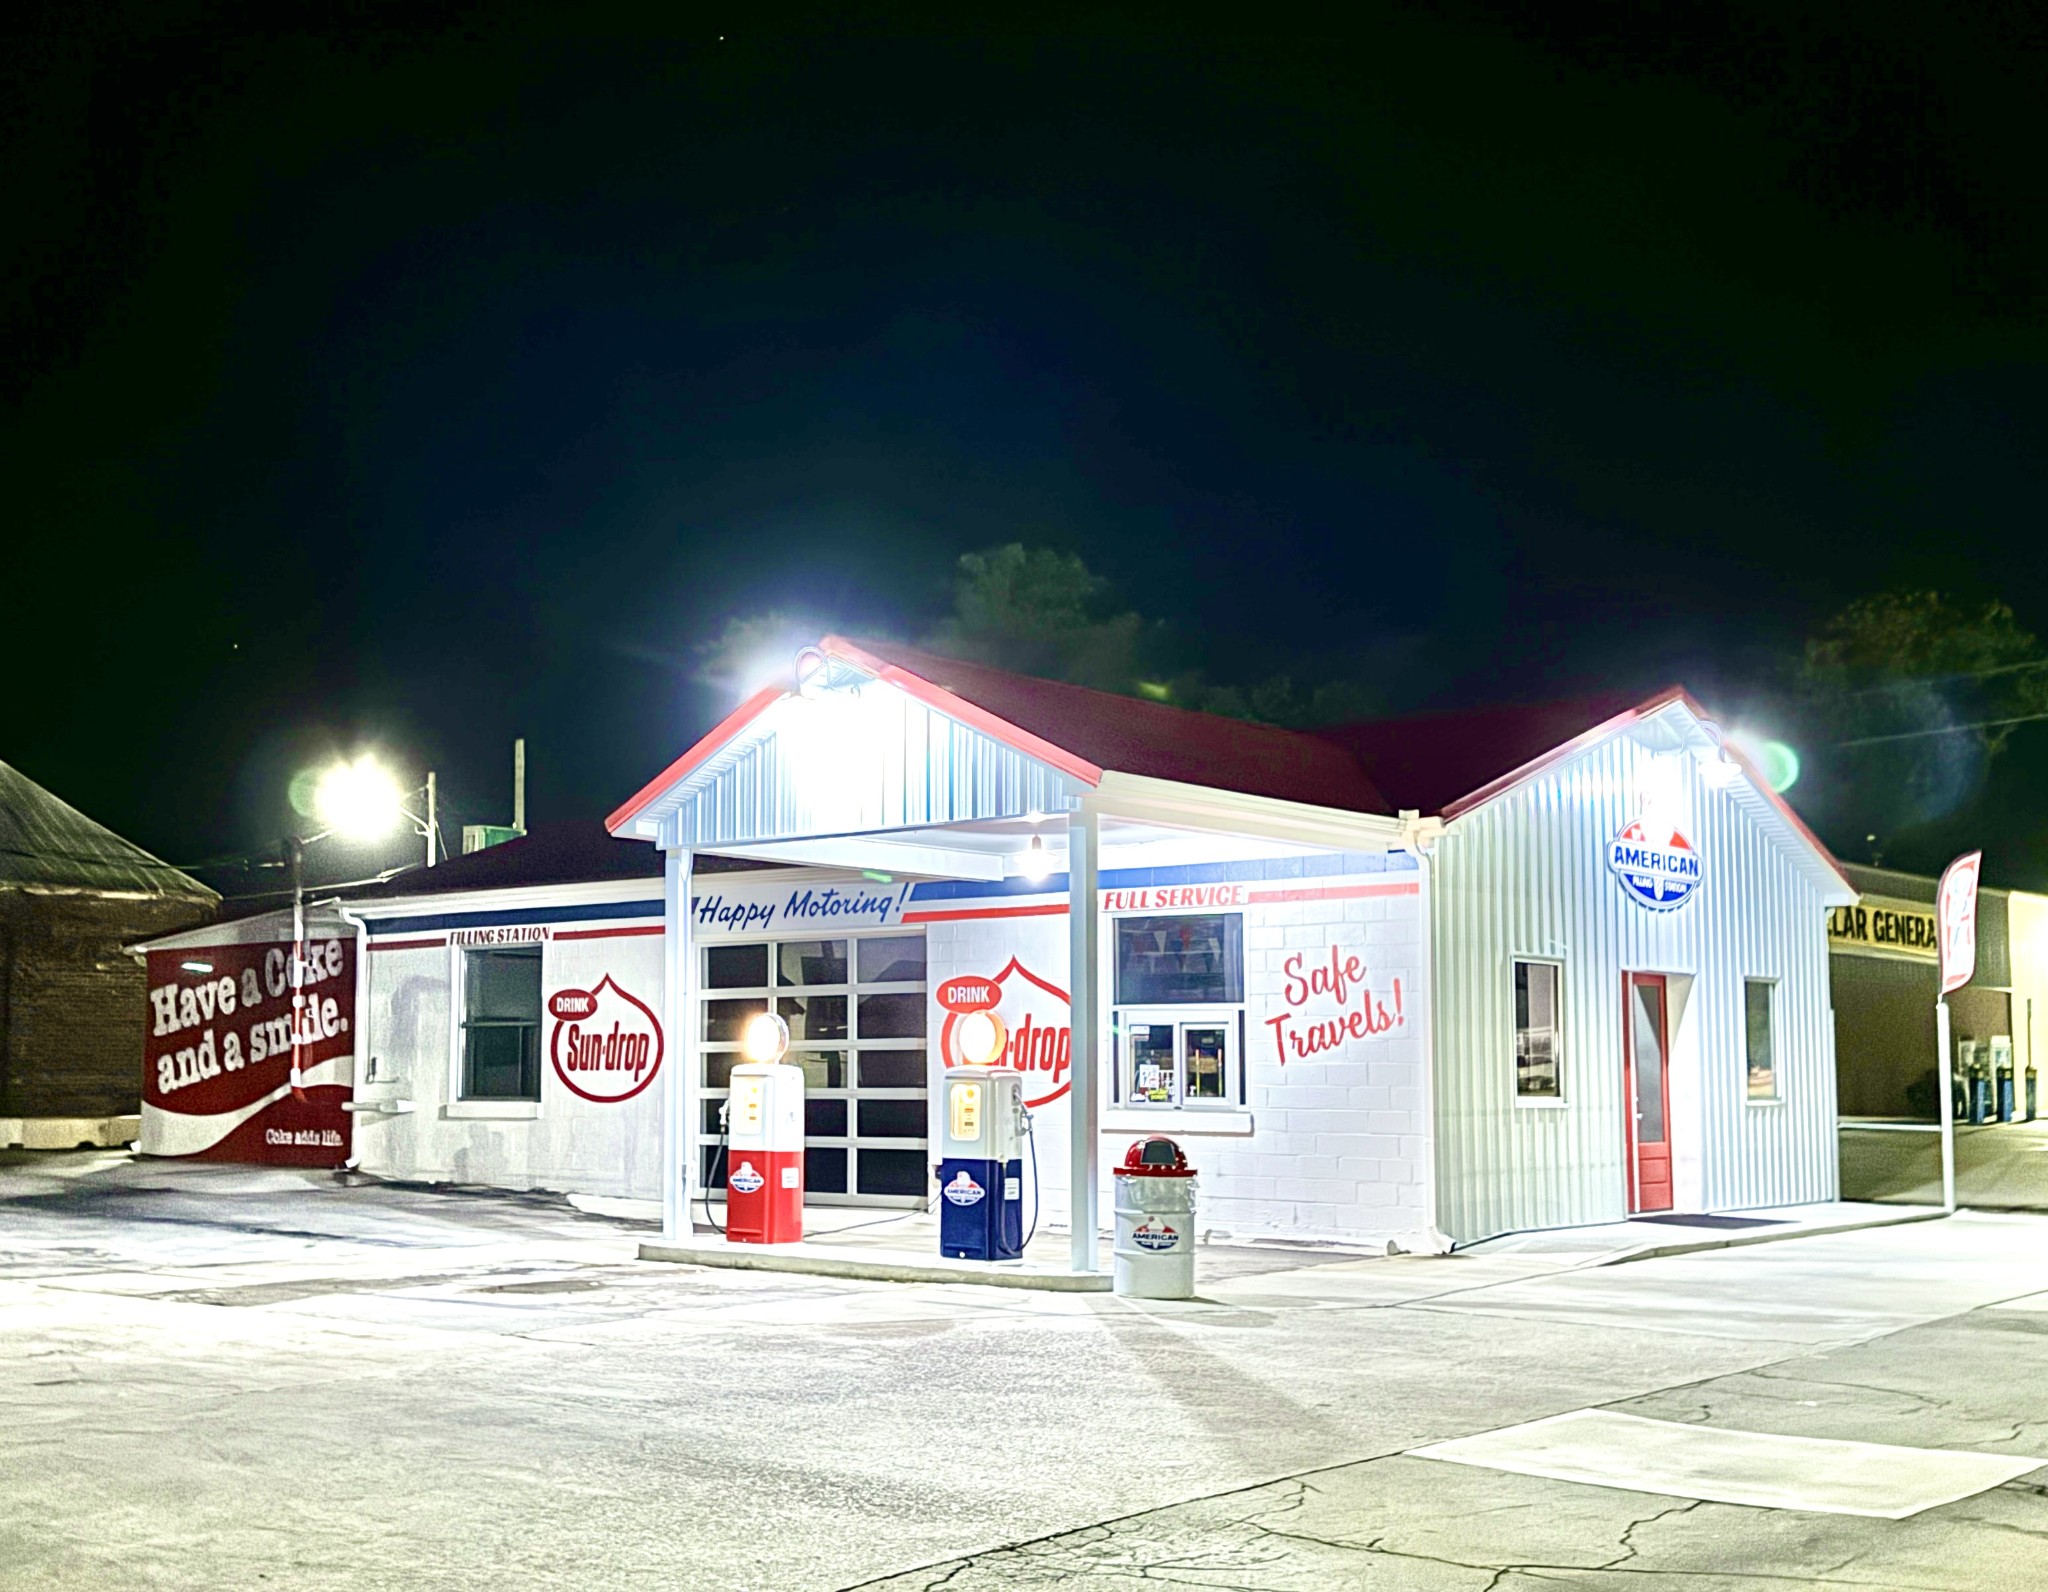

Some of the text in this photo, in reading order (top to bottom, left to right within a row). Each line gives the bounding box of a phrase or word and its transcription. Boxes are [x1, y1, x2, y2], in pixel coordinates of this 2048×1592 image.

[1614, 846, 1698, 877] AMERICAN
[699, 882, 910, 931] Happy Motoring!
[1104, 885, 1243, 910] FULL SERVICE
[450, 926, 550, 946] FILLING STATION
[1828, 906, 1868, 940] LAR
[1284, 944, 1367, 1006] Safe
[150, 975, 236, 1037] Have
[241, 968, 262, 1007] a
[556, 996, 590, 1013] DRINK
[947, 986, 990, 1004] DRINK
[1264, 978, 1404, 1067] Travels!
[157, 1029, 221, 1094] and
[224, 1031, 245, 1072] a
[266, 1129, 293, 1145] Coke
[295, 1130, 320, 1146] adds
[947, 1188, 981, 1196] AMERICAN
[1132, 1232, 1179, 1241] AMERICAN
